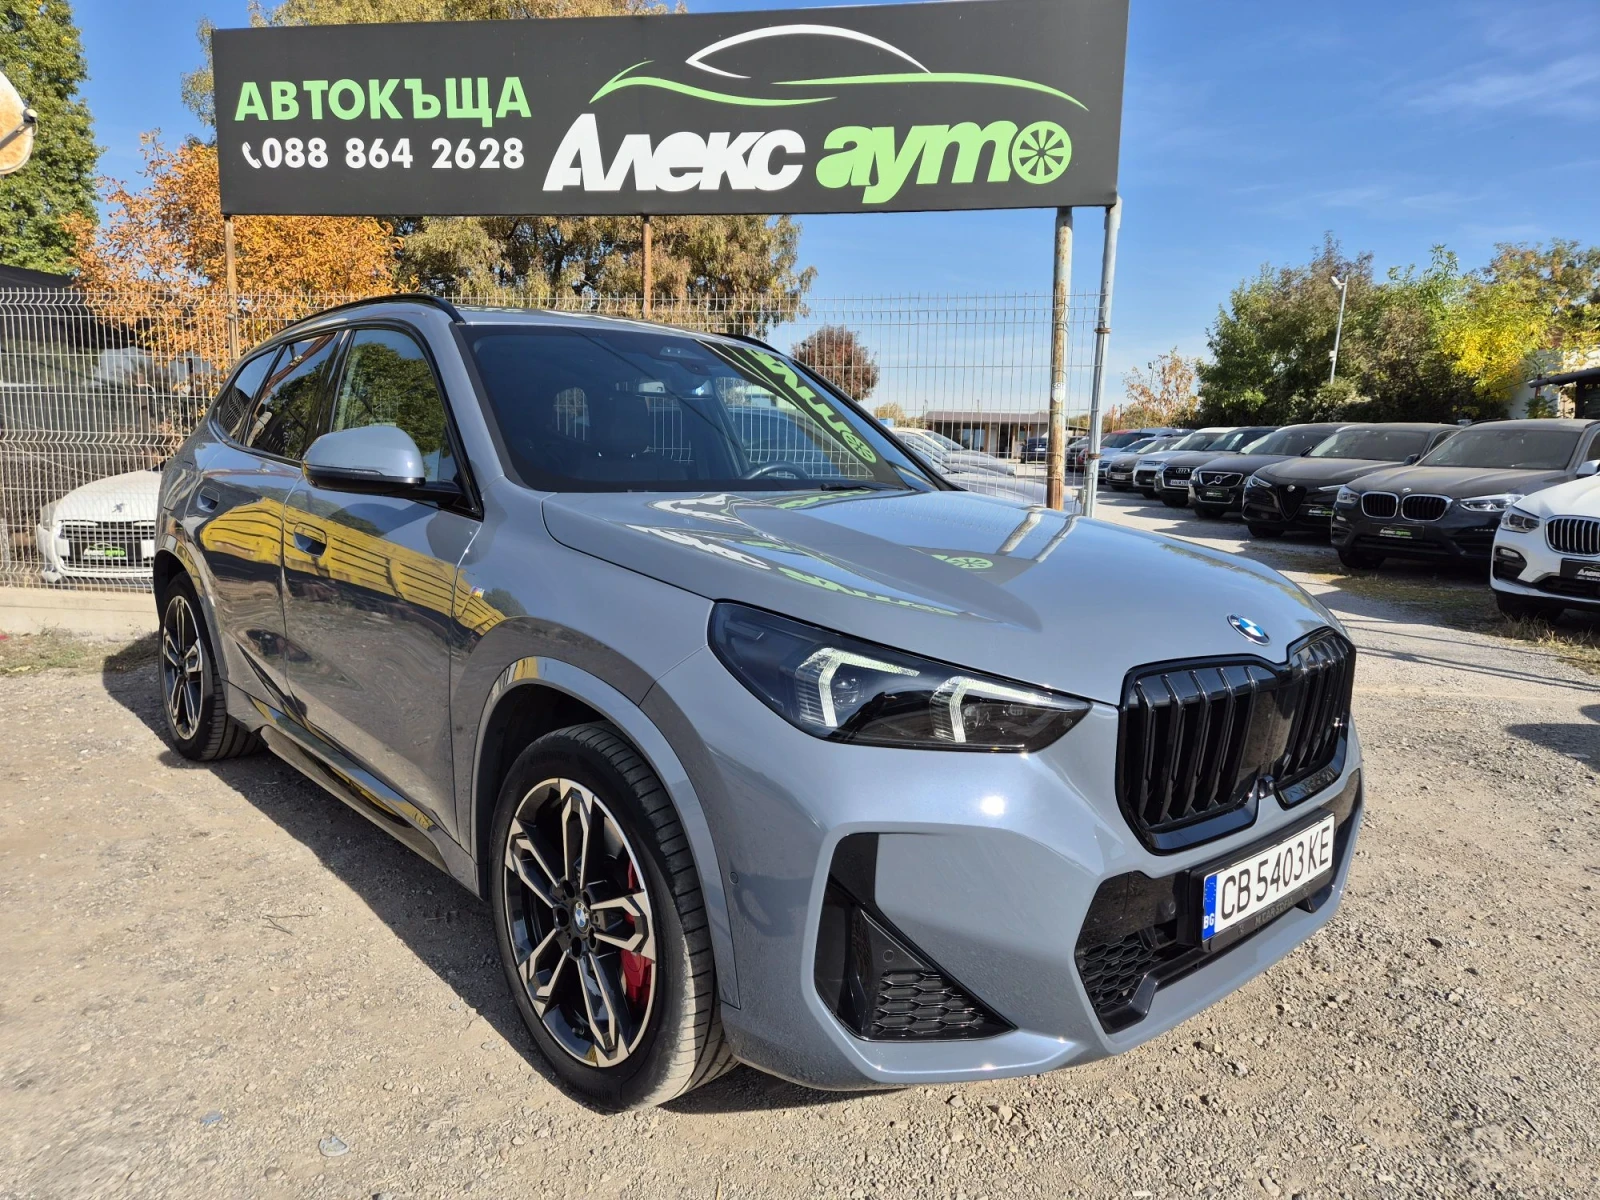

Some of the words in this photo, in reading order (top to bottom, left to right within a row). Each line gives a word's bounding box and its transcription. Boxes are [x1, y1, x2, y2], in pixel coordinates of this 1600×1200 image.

[234, 76, 532, 128] АВТОКЪЩА
[261, 137, 329, 170] 088
[345, 137, 414, 170] 864
[431, 137, 526, 170] 2628
[541, 112, 806, 193] Алекс
[1220, 867, 1252, 920] CB
[1255, 840, 1305, 903] 5403
[1307, 825, 1331, 875] KE
[1203, 912, 1215, 930] BG
